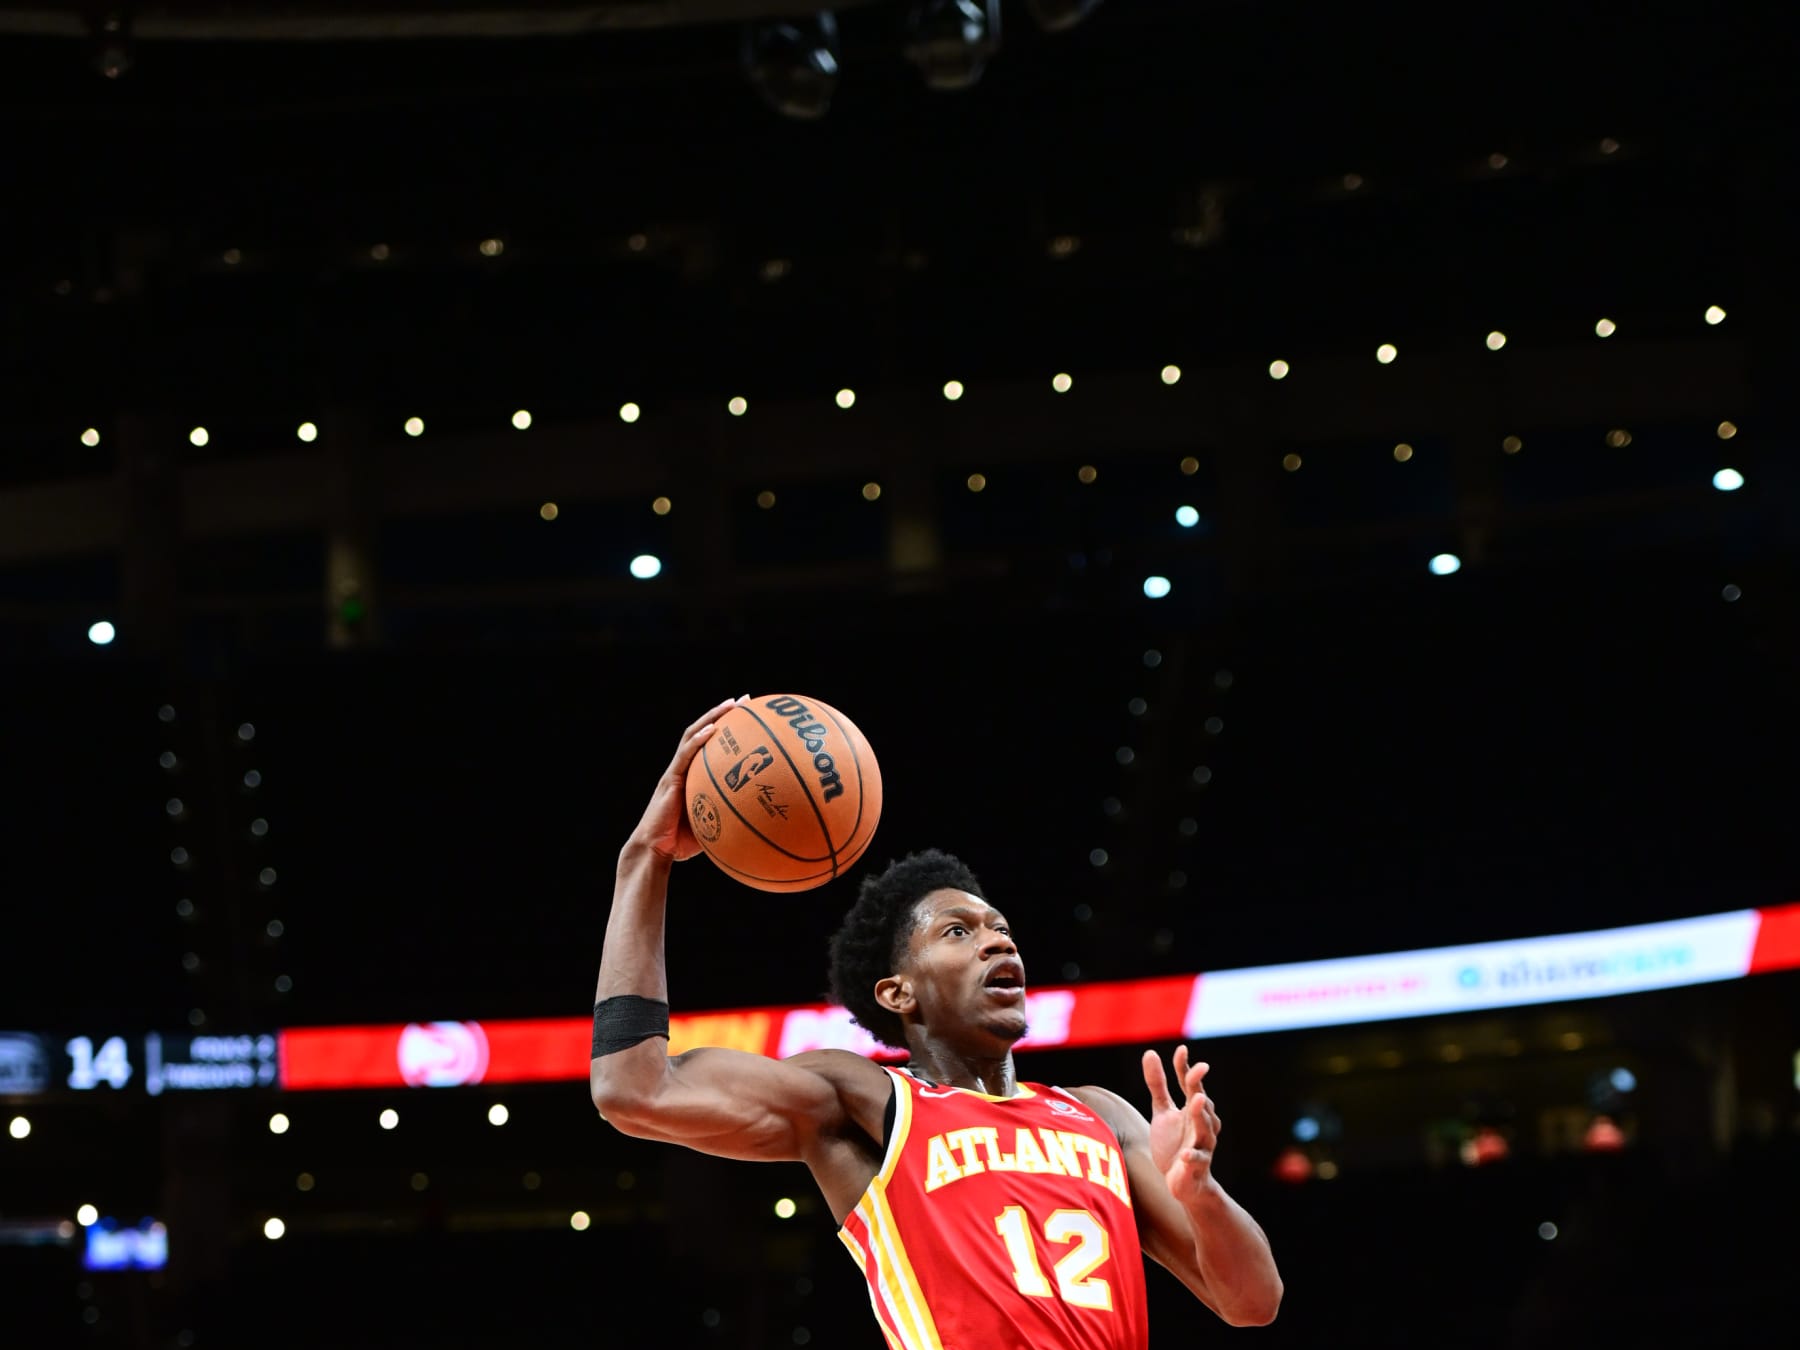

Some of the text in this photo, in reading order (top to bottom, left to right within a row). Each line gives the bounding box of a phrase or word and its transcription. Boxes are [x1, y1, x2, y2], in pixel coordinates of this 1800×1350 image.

[766, 696, 843, 803] Wilson
[65, 1036, 133, 1090] 14
[924, 1126, 1133, 1209] ATLANTA
[994, 1205, 1114, 1312] 12
